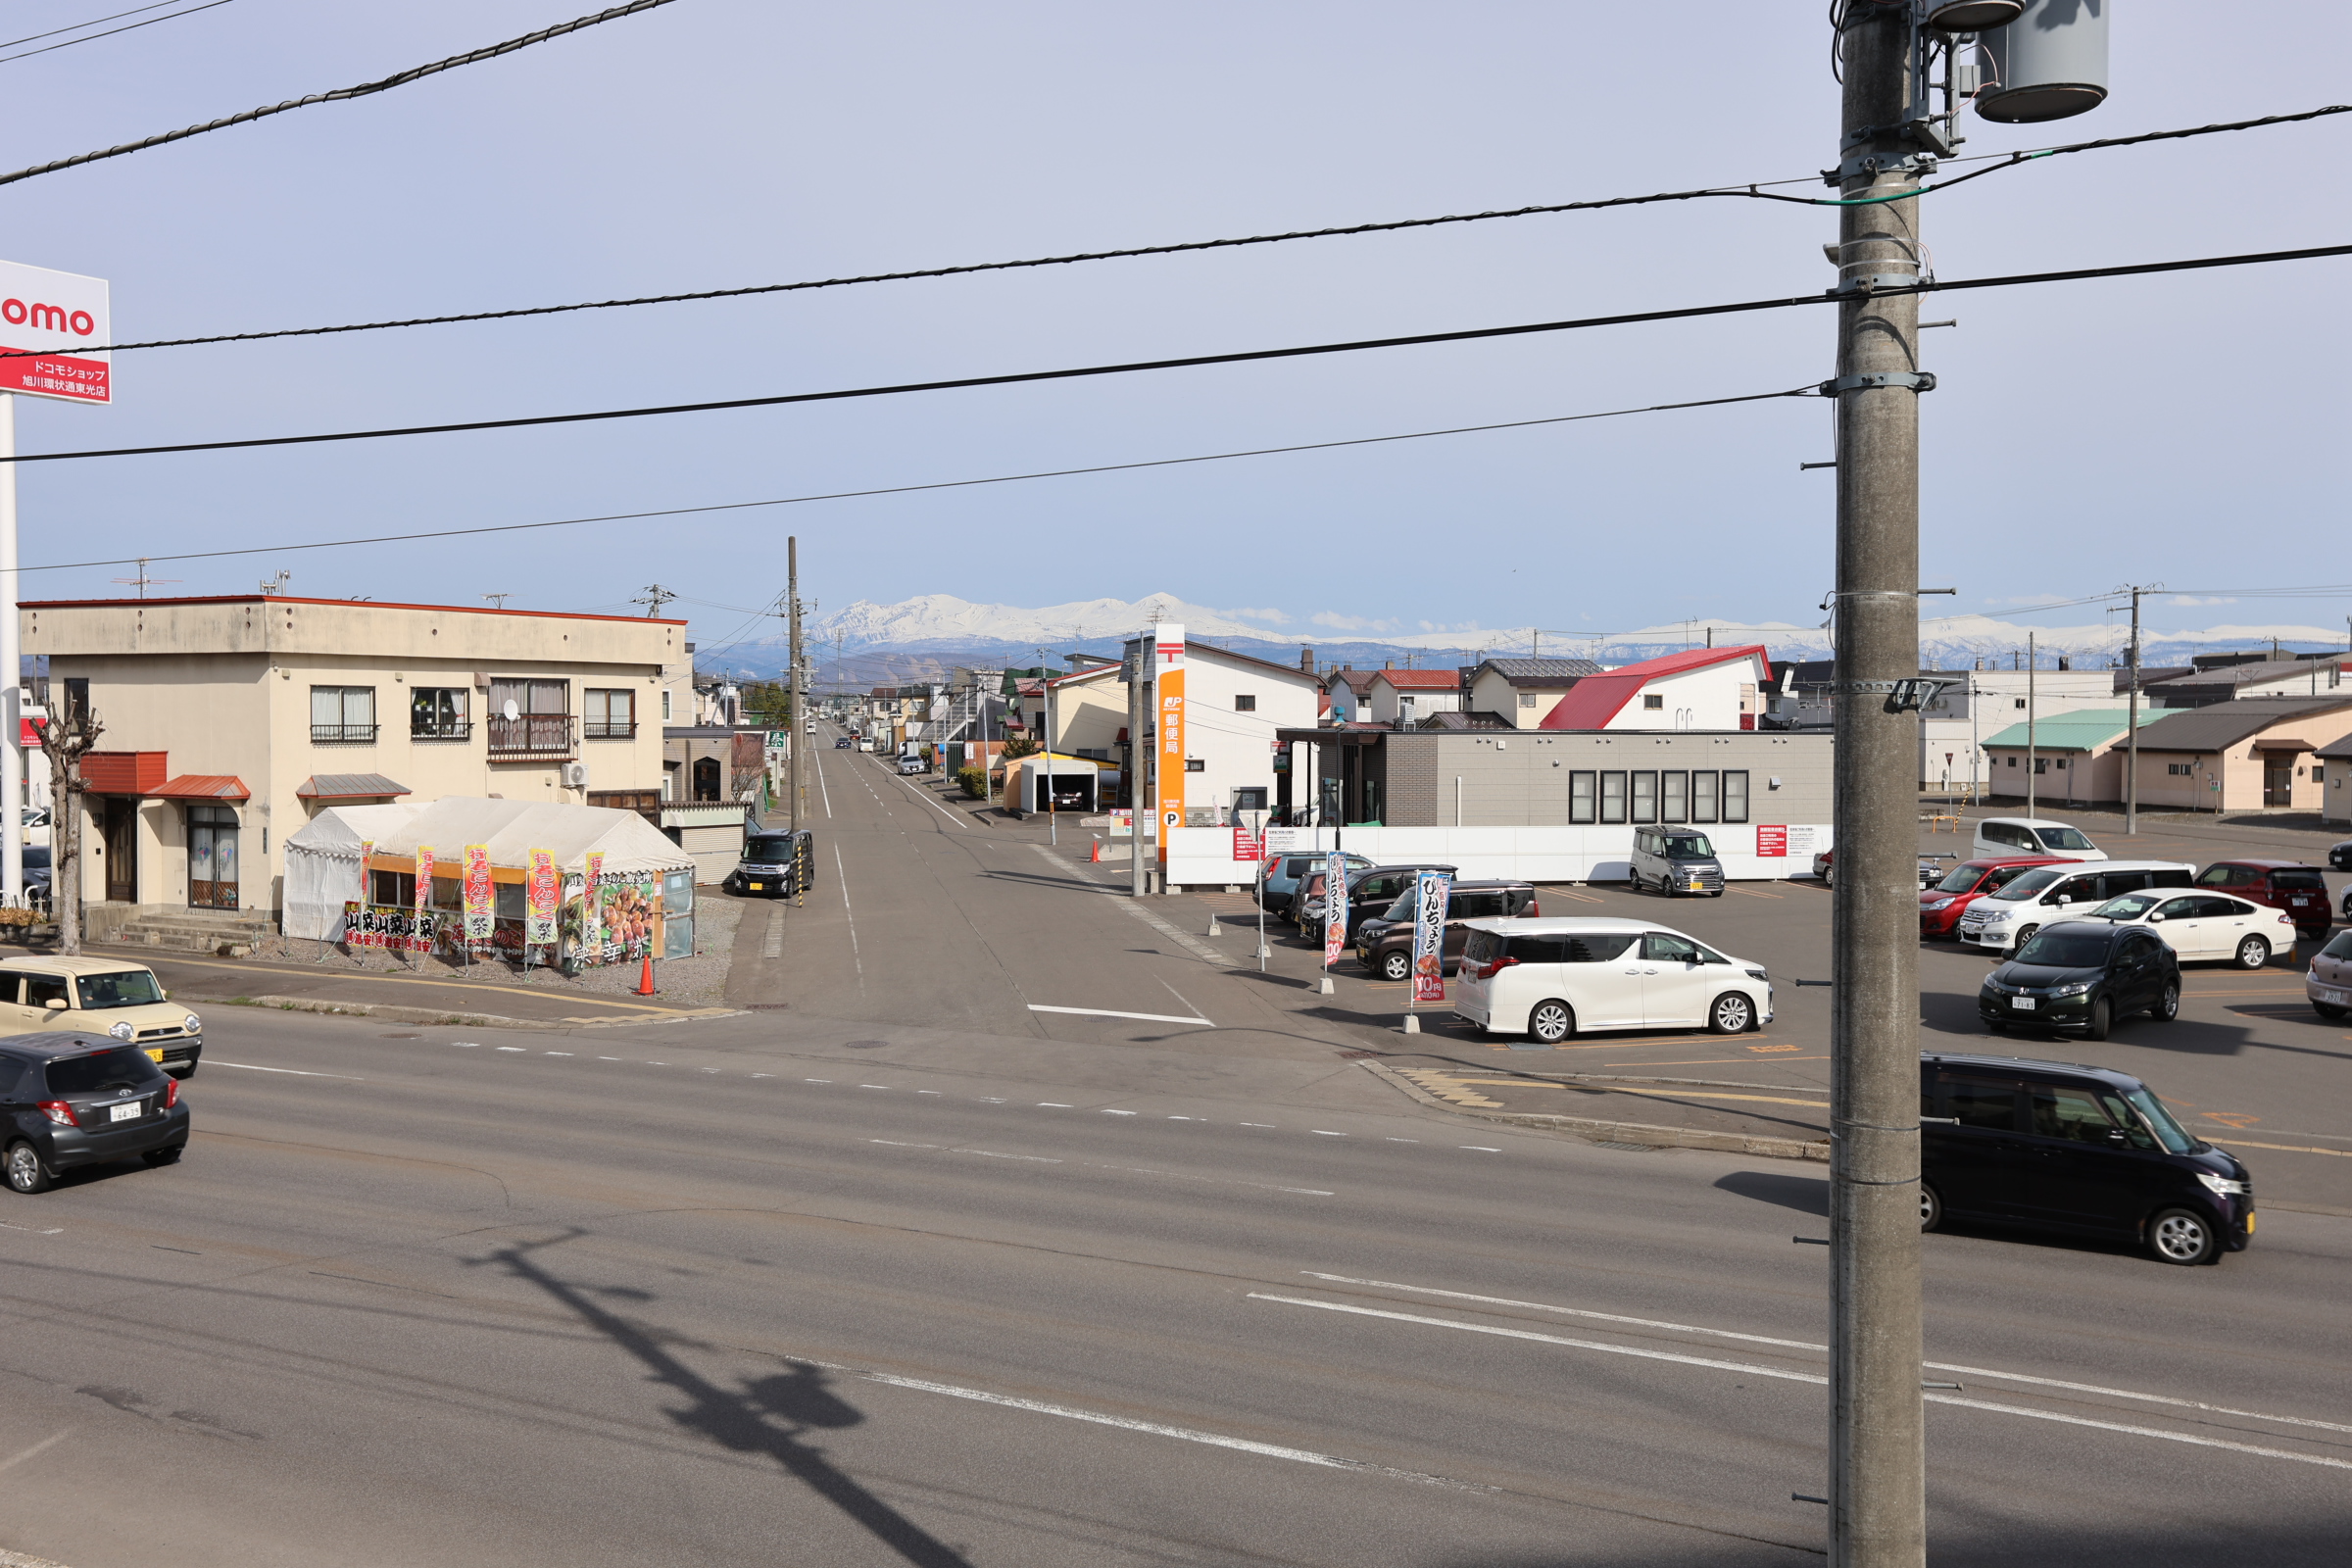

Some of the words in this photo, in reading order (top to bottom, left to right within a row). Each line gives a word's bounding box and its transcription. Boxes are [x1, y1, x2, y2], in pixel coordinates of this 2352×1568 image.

[35, 361, 106, 381] ドコモショップ
[23, 374, 106, 397] 旭川環状通東光店
[1165, 713, 1179, 754] 郵便局
[1167, 813, 1177, 825] P
[376, 914, 405, 935] 山菜
